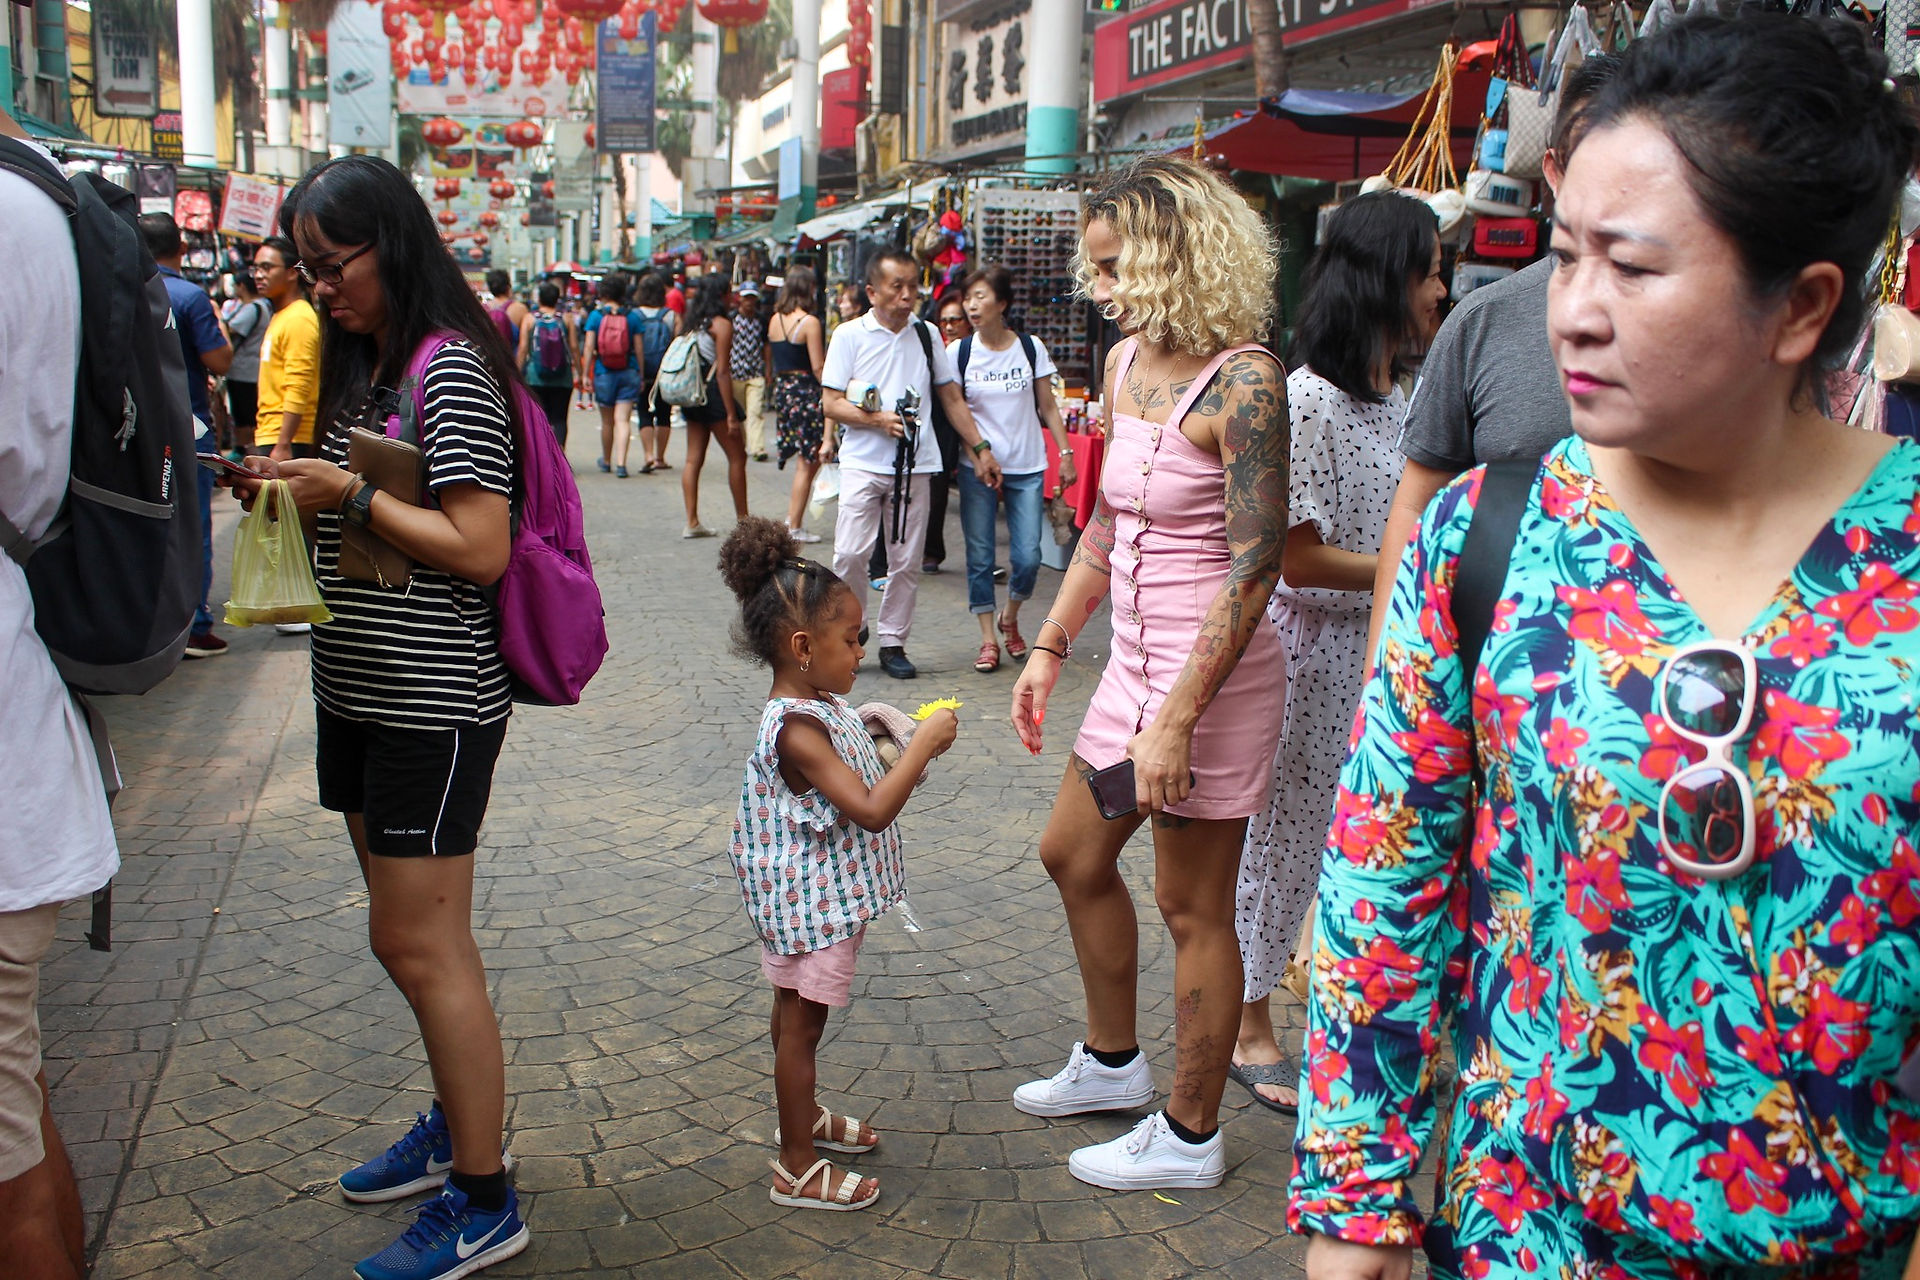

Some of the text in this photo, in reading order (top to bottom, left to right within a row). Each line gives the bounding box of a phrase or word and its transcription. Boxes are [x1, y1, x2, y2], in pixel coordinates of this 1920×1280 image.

[102, 35, 149, 57] TOWN
[1129, 14, 1173, 75] THE
[112, 58, 139, 79] INN
[153, 132, 183, 145] CHIN
[1005, 380, 1028, 392] pop
[161, 458, 172, 500] ARPENAZ
